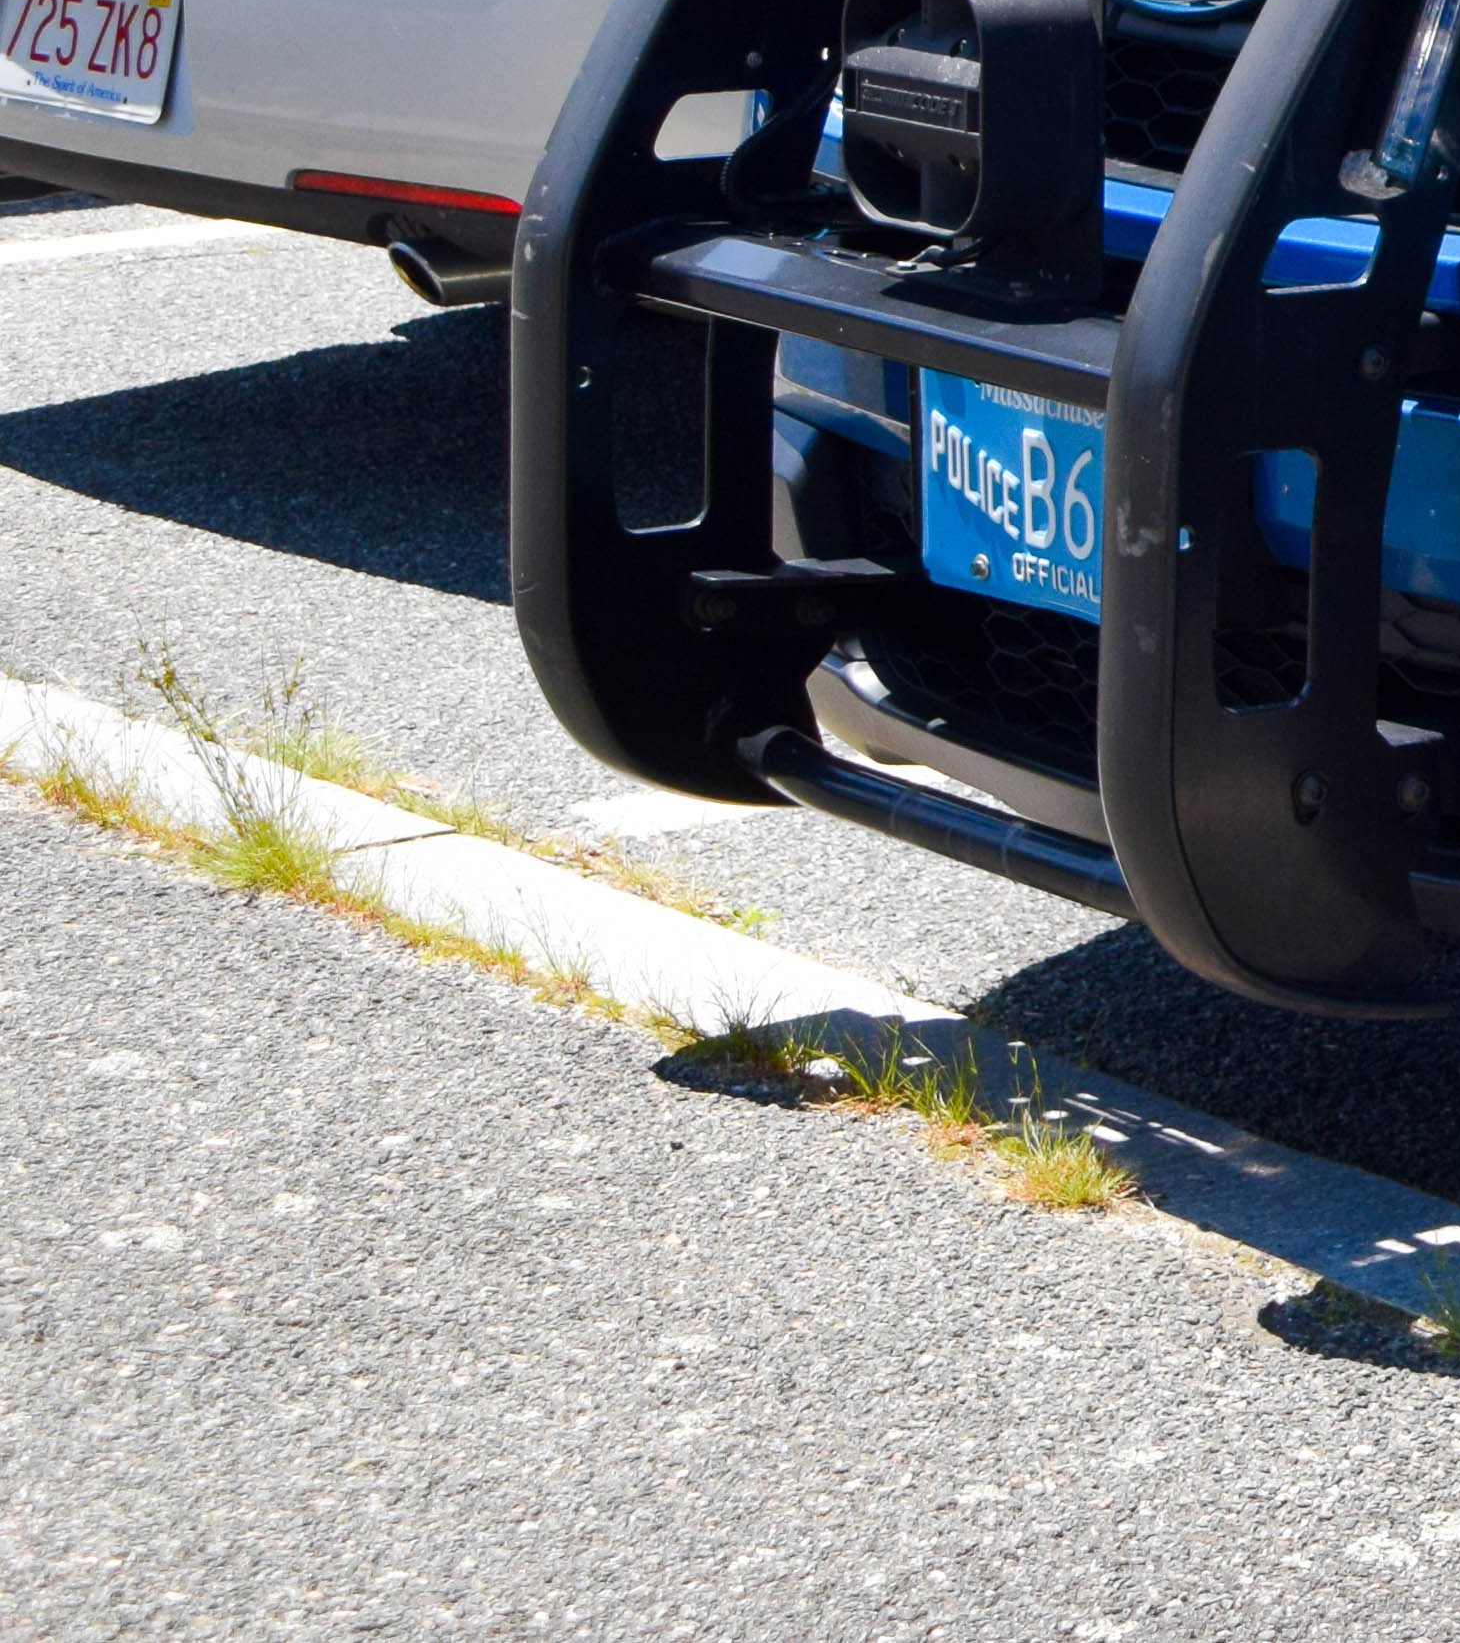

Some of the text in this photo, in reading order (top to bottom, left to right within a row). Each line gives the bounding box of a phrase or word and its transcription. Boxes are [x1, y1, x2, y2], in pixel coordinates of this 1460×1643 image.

[88, 0, 162, 79] ZK8
[931, 409, 1020, 540] POLICE
[1012, 552, 1100, 603] OFFICIAL
